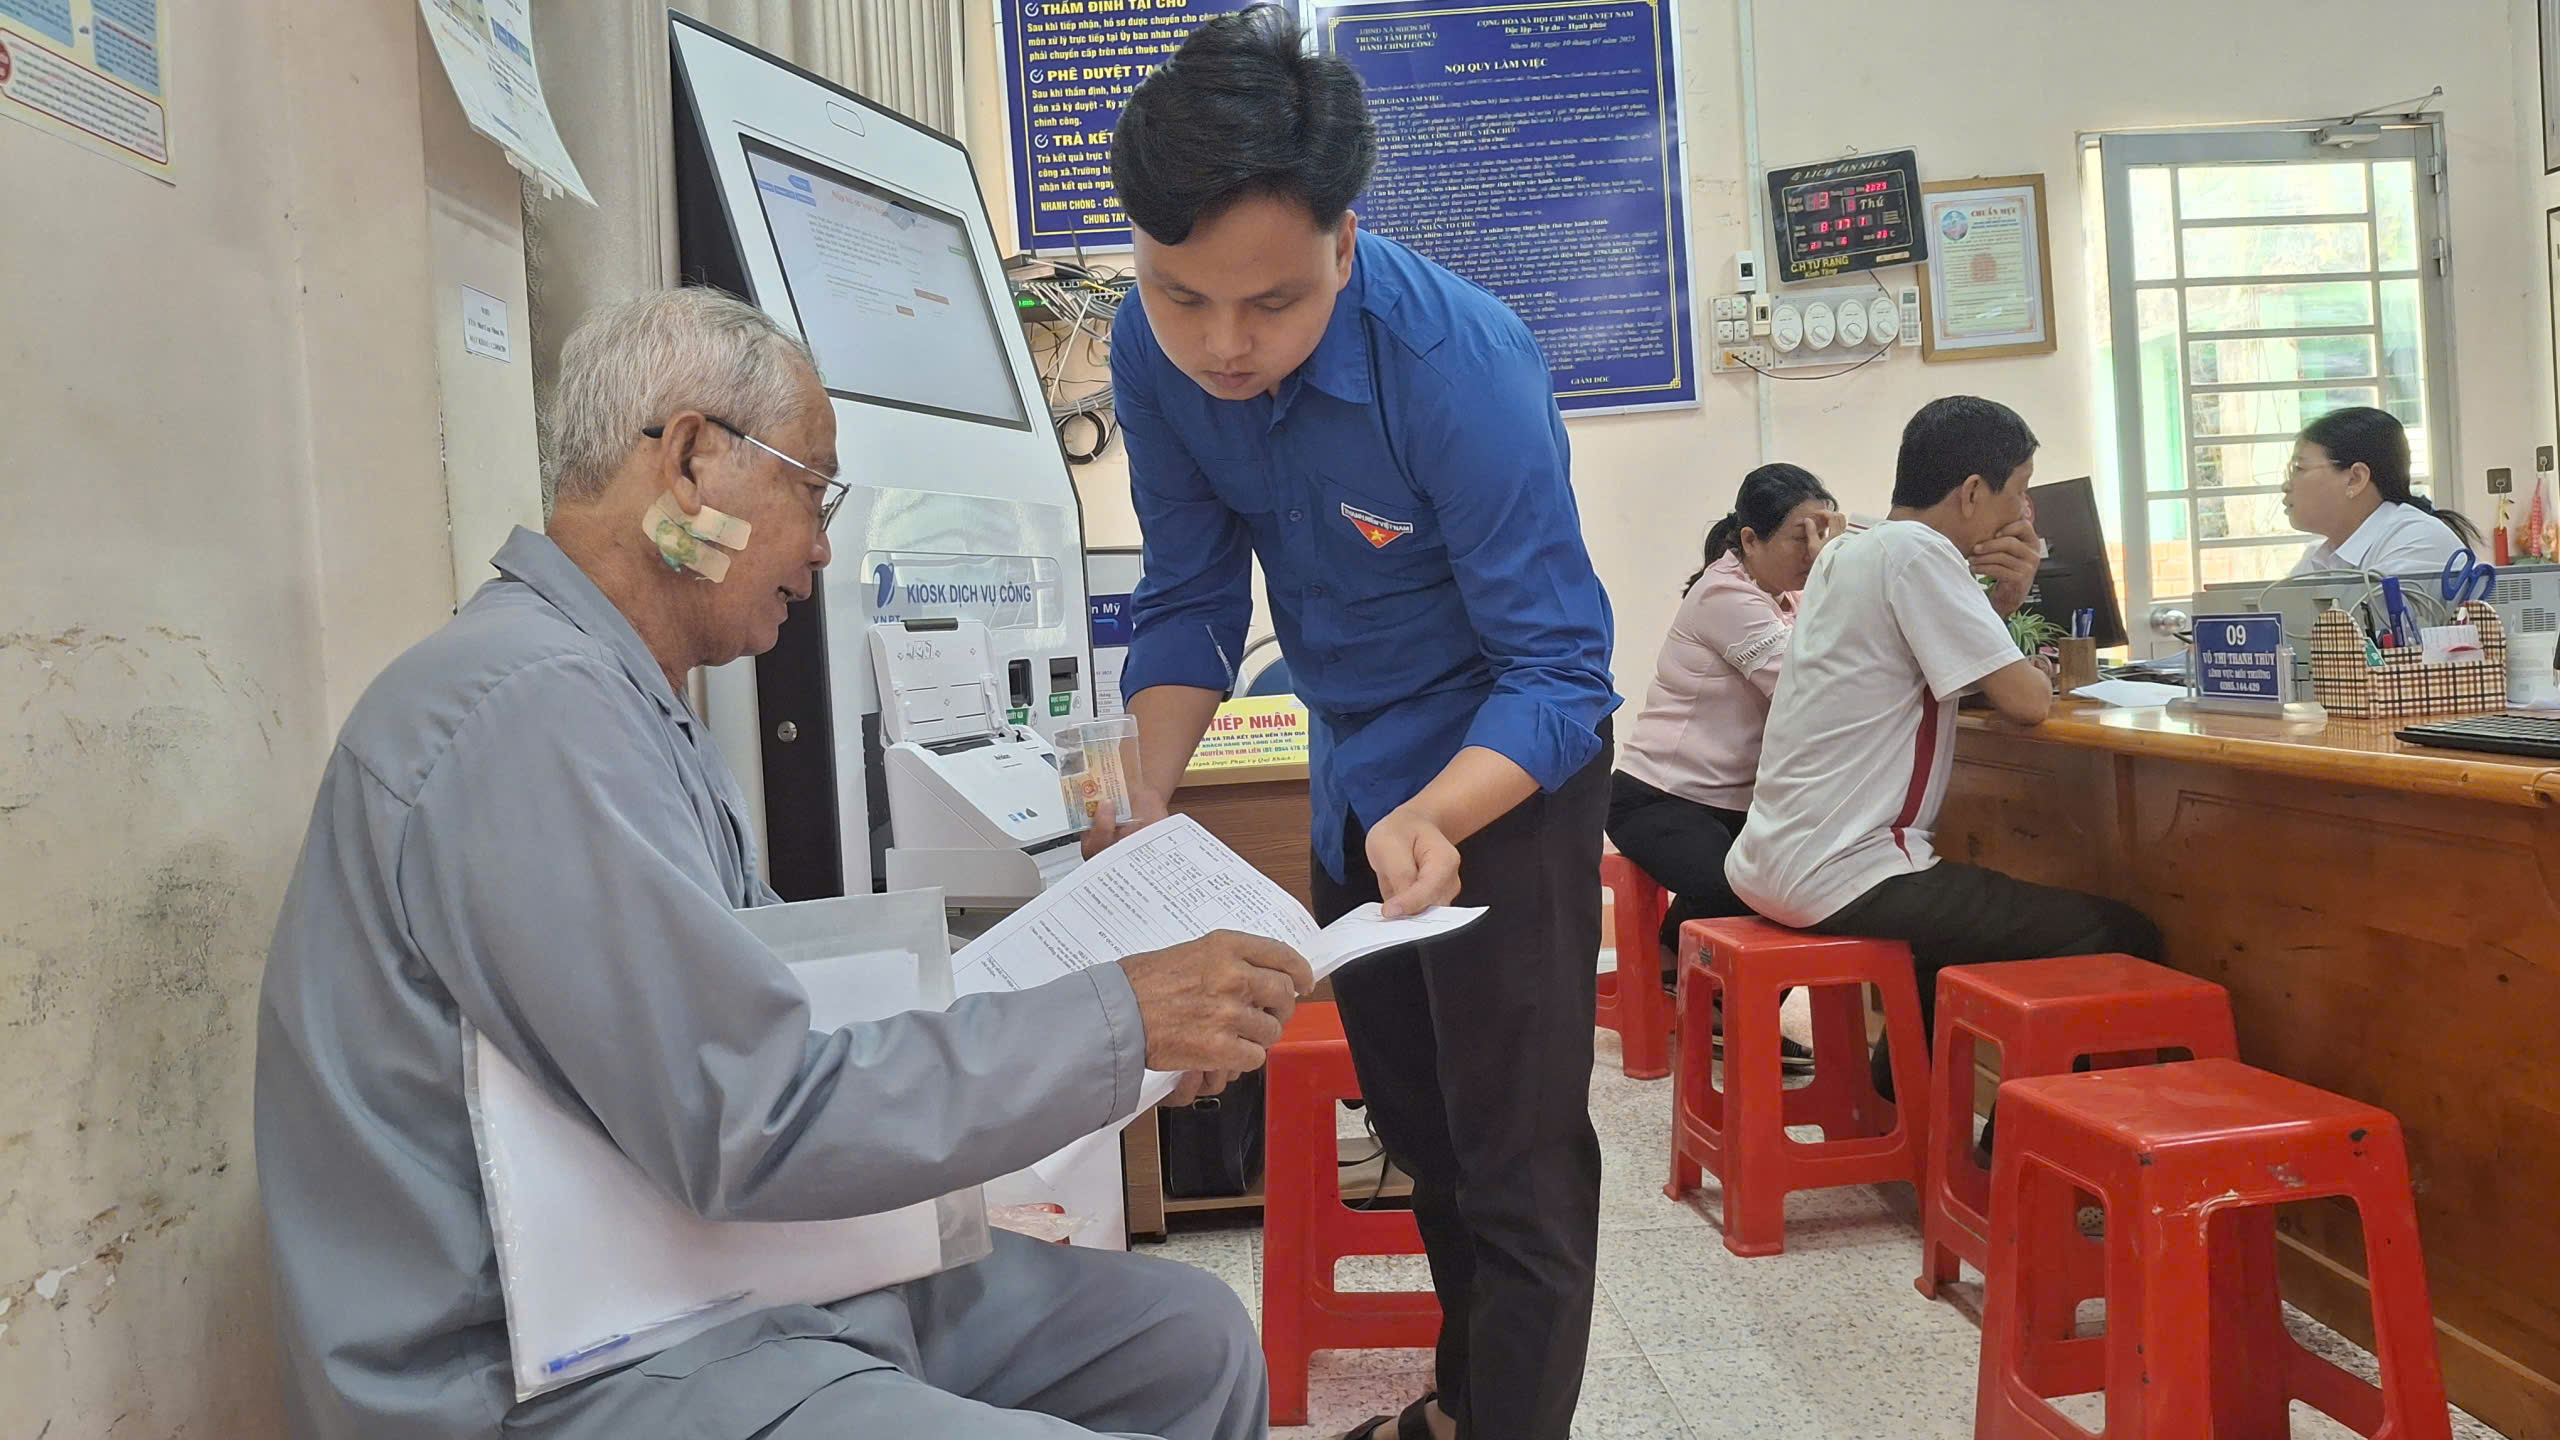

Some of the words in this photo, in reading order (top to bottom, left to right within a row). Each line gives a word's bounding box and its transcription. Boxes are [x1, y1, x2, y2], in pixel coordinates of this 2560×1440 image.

[1041, 0, 1084, 15] THẨM
[1088, 0, 1124, 14] ĐỊNH
[1128, 0, 1151, 11] TẠI
[1616, 10, 1634, 18] NAM
[1027, 23, 1043, 32] Sau
[1045, 22, 1058, 31] khi
[1060, 19, 1077, 31] tiếp
[1103, 17, 1114, 27] hồ
[1116, 19, 1126, 27] sơ
[1128, 17, 1148, 27] được
[1150, 13, 1180, 25] chuyển
[1182, 14, 1197, 23] cho
[1028, 37, 1046, 46] môn
[1060, 35, 1067, 46] lý
[1069, 35, 1087, 44] trực
[1088, 33, 1105, 44] tiếp
[1106, 32, 1118, 42] tại
[1132, 31, 1149, 40] ban
[1151, 29, 1171, 39] nhân
[1173, 28, 1190, 38] dân
[1426, 32, 1438, 40] VỤ
[1029, 50, 1048, 62] phải
[1050, 48, 1079, 60] chuyển
[1081, 47, 1097, 59] cấp
[1098, 47, 1116, 56] trên
[1118, 44, 1133, 55] nếu
[1135, 45, 1159, 55] thuộc
[1047, 67, 1078, 82] PHÊ
[1083, 64, 1132, 81] DUYỆT
[1444, 63, 1465, 75] NỘI
[1467, 61, 1491, 72] QUY
[1494, 58, 1520, 70] LÀM
[1522, 57, 1549, 69] VIỆC
[1032, 89, 1048, 99] Sau
[1050, 88, 1063, 98] khi
[1065, 86, 1086, 97] thẩm
[1111, 84, 1121, 94] hồ
[1123, 85, 1133, 93] sơ
[1033, 103, 1049, 113] dân
[1074, 100, 1098, 112] duyệt
[1034, 117, 1057, 127] chính
[1052, 131, 1084, 146] TRẢ
[1036, 153, 1051, 164] Trả
[1053, 152, 1066, 162] kết
[1068, 152, 1084, 163] quả
[1086, 152, 1103, 161] trực
[1038, 168, 1059, 179] công
[1039, 182, 1060, 192] nhận
[1061, 180, 1075, 191] kết
[1077, 180, 1093, 191] quả
[1040, 201, 1068, 212] NHANH
[1860, 195, 1884, 210] Thứ
[1083, 214, 1110, 225] CHUNG
[1111, 212, 1126, 223] TAY
[907, 583, 947, 604] KIOSK
[950, 584, 979, 608] DỊCH
[981, 584, 997, 607] VỤ
[1000, 581, 1032, 603] CÔNG
[1103, 601, 1121, 616] Mỹ
[872, 615, 900, 624] VNPT
[2226, 624, 2246, 646] 09
[2213, 652, 2226, 667] THỊ
[2227, 652, 2253, 665] THANH
[1210, 713, 1244, 731] TIẾP
[1249, 712, 1296, 730] NHẬN
